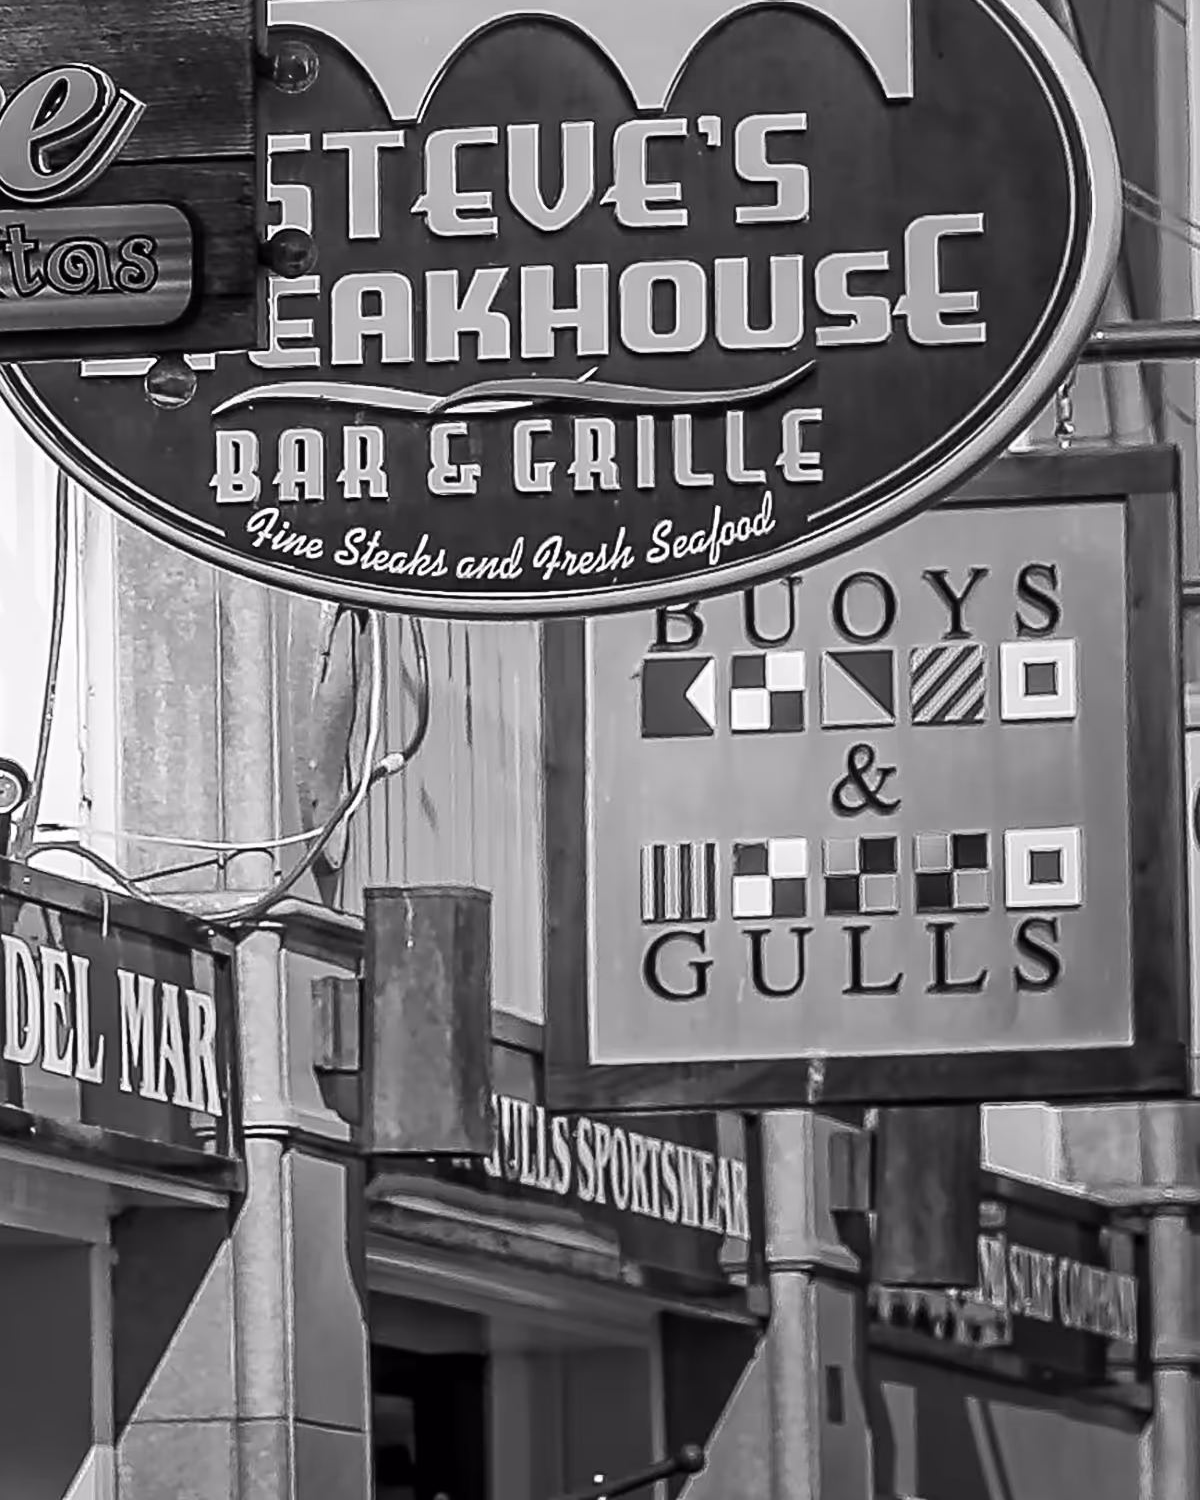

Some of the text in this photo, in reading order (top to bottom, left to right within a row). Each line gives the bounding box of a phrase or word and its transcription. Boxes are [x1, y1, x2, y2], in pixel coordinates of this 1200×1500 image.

[80, 213, 987, 377] EAKHOUSE
[208, 407, 825, 504] BAR & GRILLE
[246, 491, 777, 581] Fine Steaks and Fresh Seafood
[649, 563, 1063, 652] BUOYS
[831, 741, 902, 817] &
[641, 917, 1063, 1000] GULLS
[1, 934, 104, 1084] DEL
[117, 968, 222, 1117] MAR
[576, 1116, 750, 1241] SPORTSWEAR
